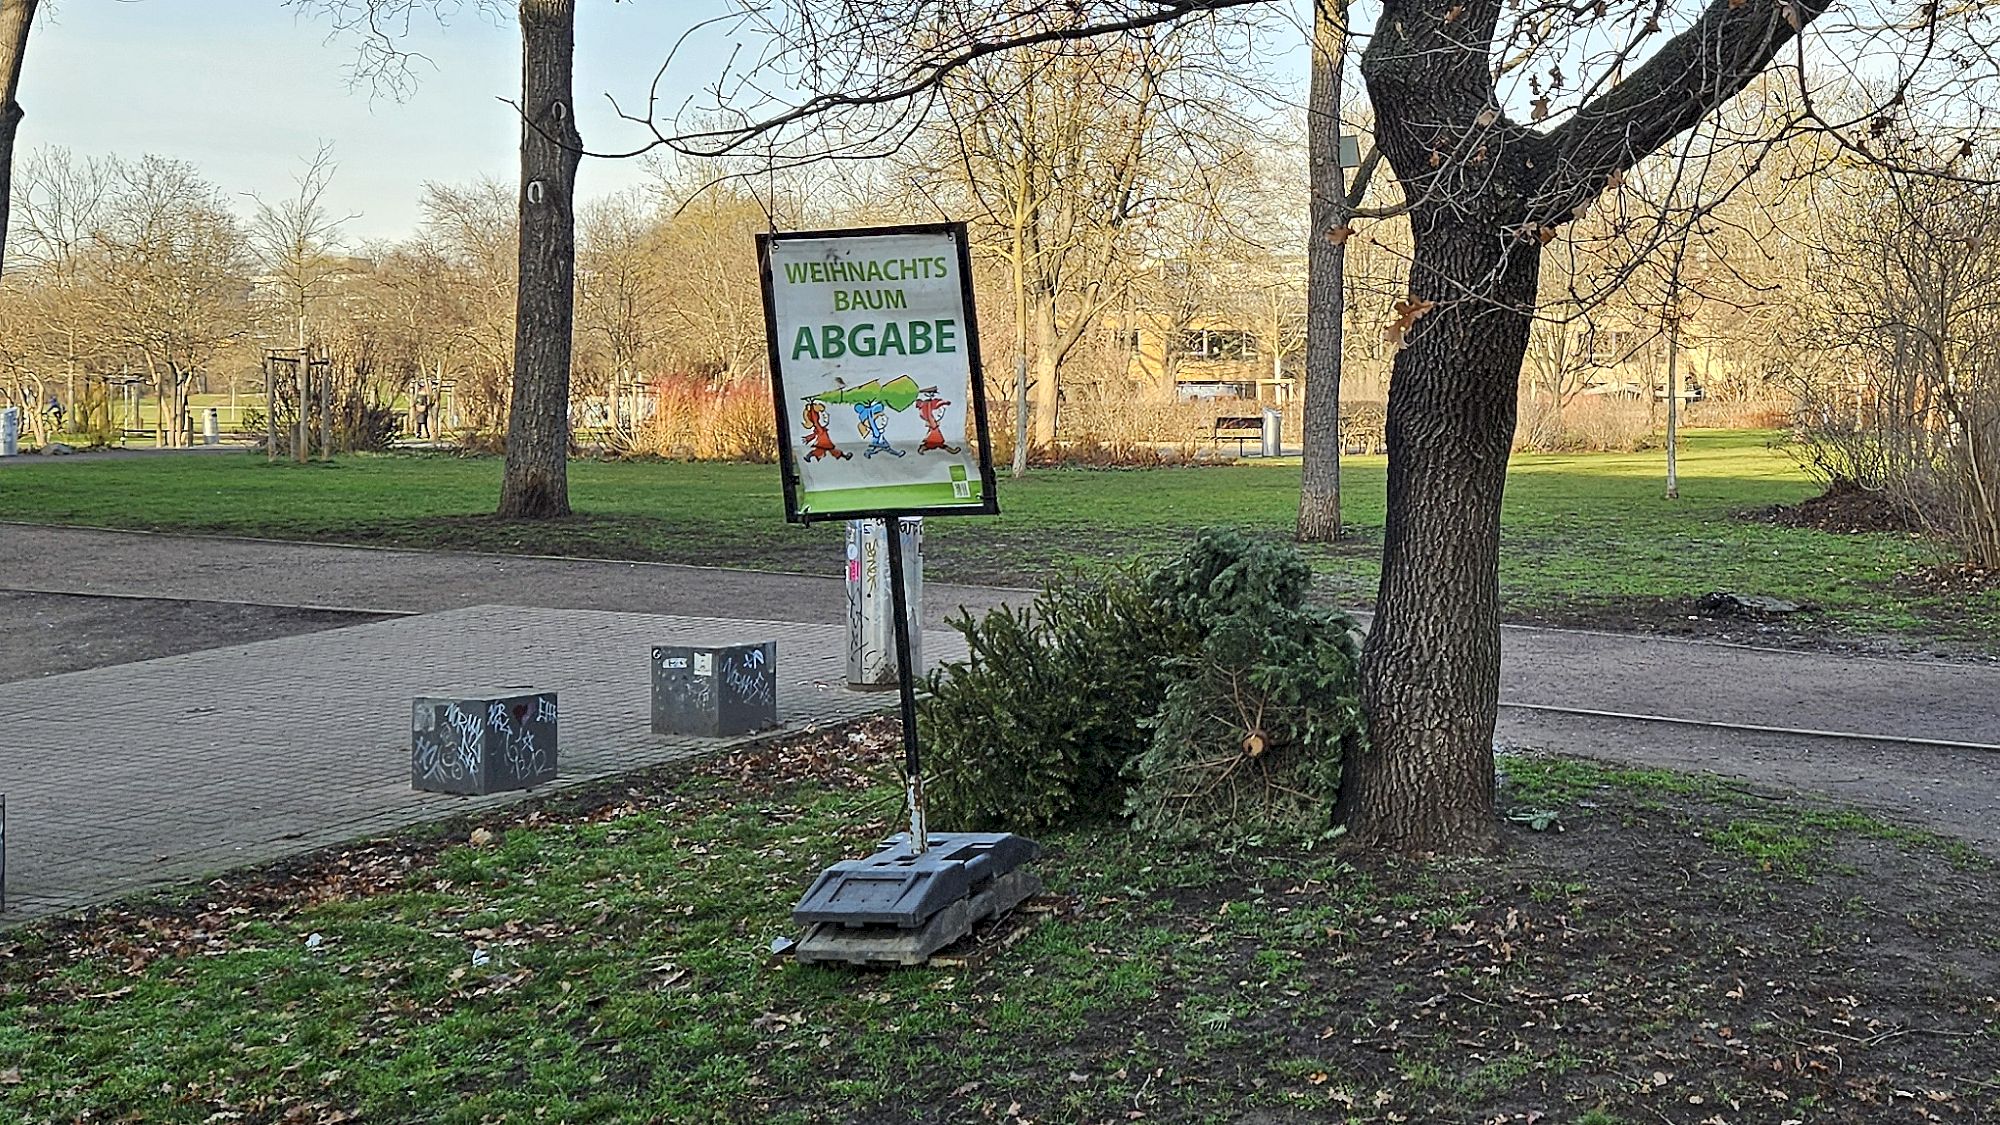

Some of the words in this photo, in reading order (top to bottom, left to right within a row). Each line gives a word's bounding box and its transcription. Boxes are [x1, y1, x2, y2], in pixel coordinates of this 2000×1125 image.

[784, 256, 948, 284] WEIHNACHTS
[833, 289, 908, 311] BAUM
[791, 319, 957, 361] ABGABE
